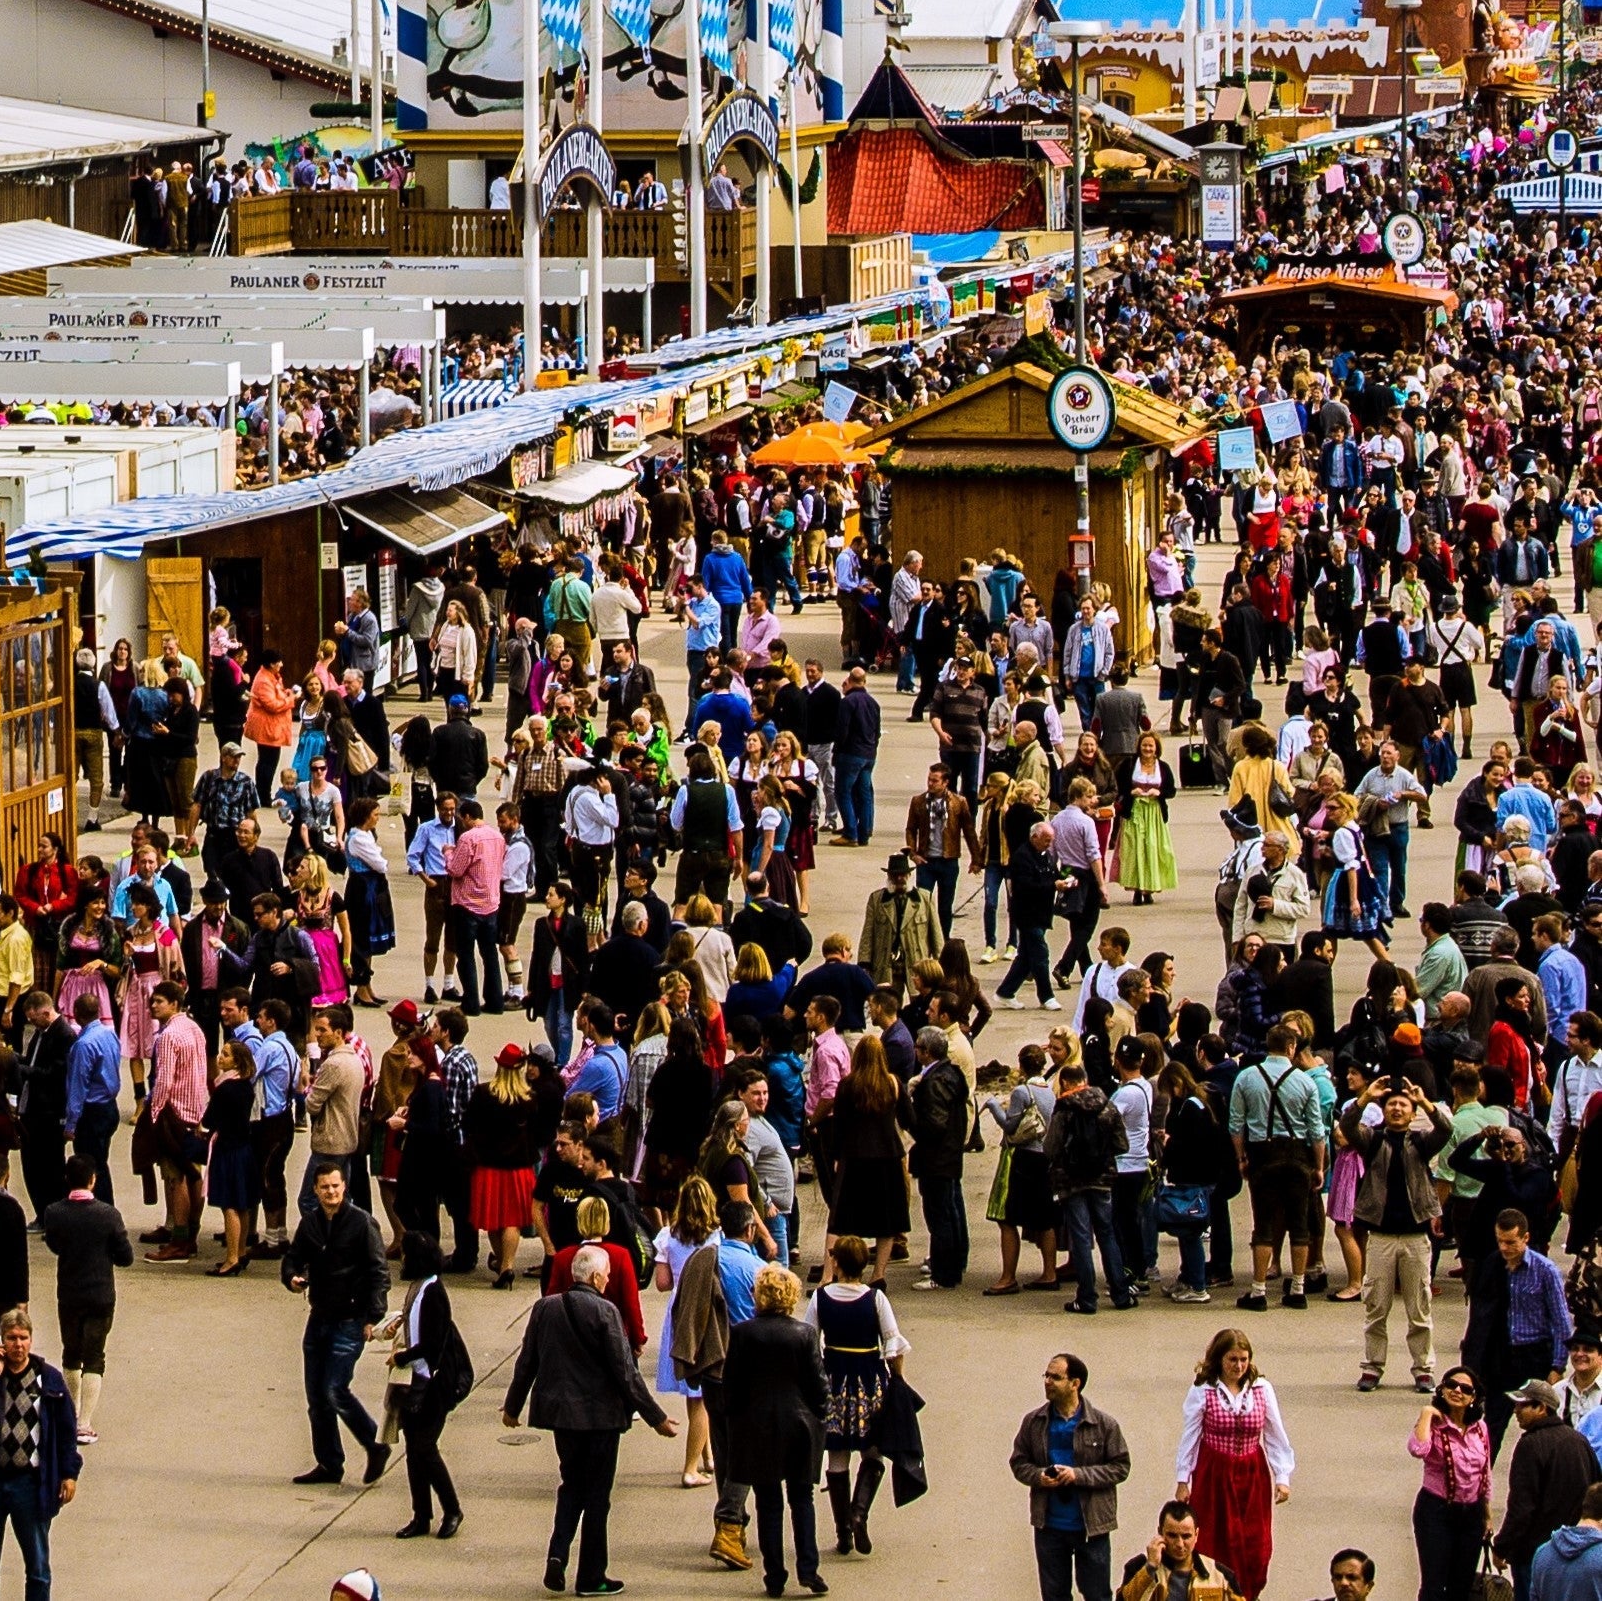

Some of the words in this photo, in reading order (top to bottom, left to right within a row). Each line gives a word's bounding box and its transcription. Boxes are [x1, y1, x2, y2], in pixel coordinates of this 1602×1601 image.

[1276, 263, 1331, 280] Heisse
[1335, 262, 1384, 280] Nüsse
[230, 275, 300, 289] PAULANER
[323, 276, 387, 289] FESTZELT
[49, 312, 125, 328] PAULANER
[152, 313, 222, 328] FESTZELT
[820, 347, 846, 358] KÄSE
[1062, 413, 1100, 424] Pschorr
[1069, 424, 1095, 435] Bräu
